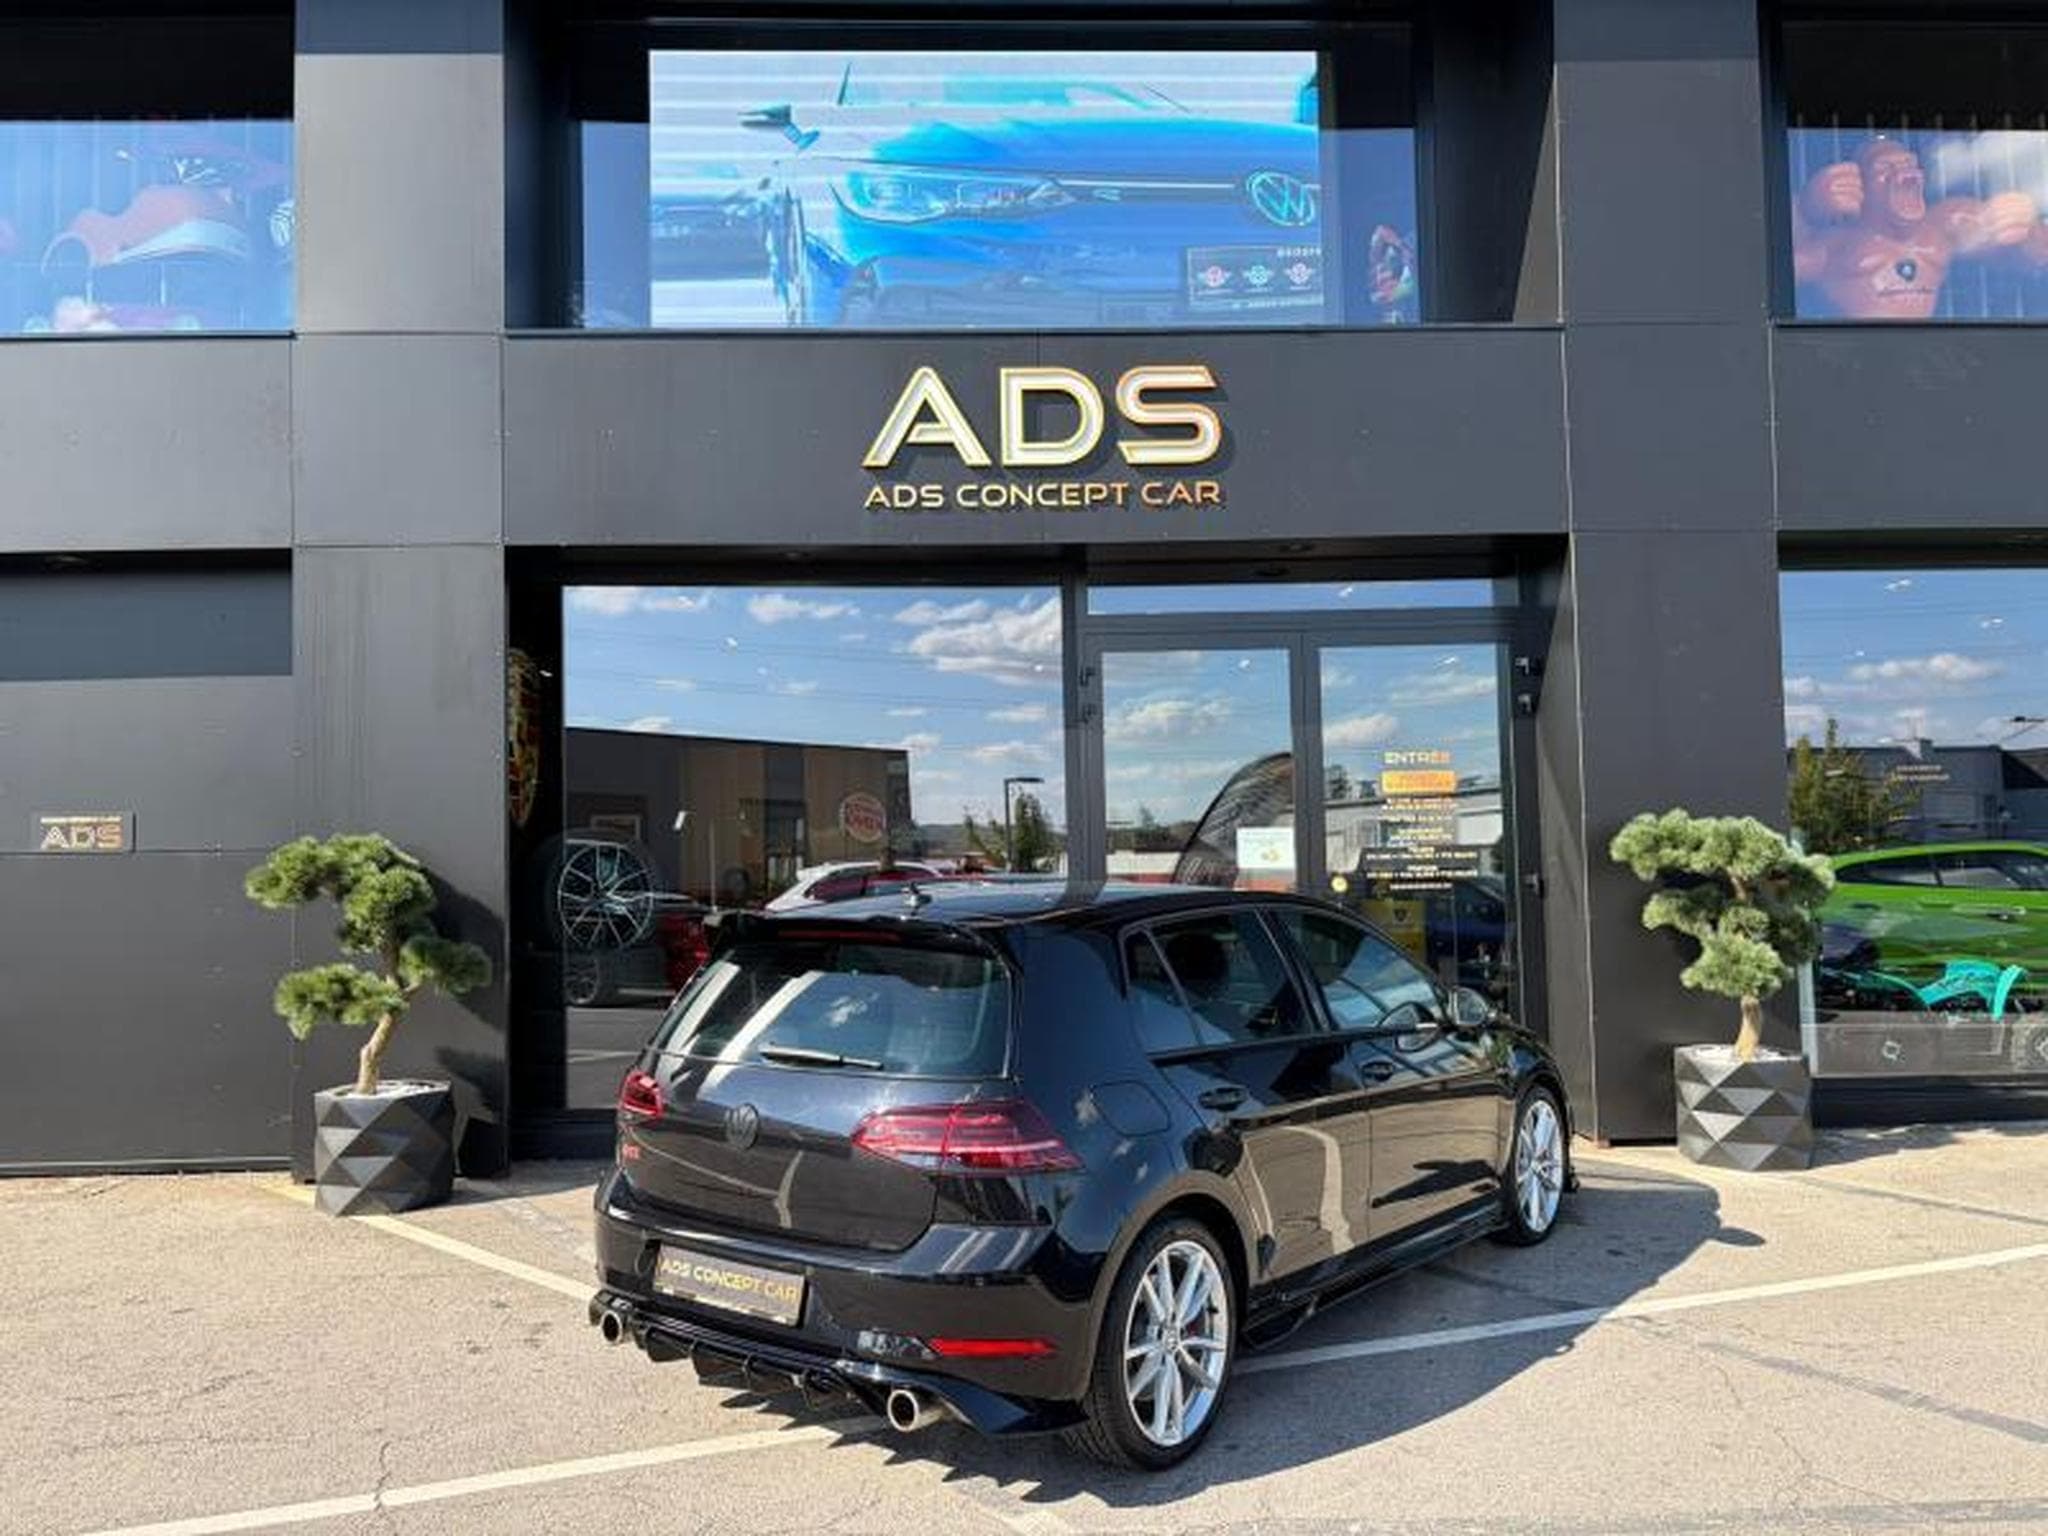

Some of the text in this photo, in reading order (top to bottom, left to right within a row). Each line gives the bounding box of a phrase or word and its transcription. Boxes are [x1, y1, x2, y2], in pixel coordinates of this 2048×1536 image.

[861, 365, 1223, 467] ADS
[864, 481, 1222, 508] ADS CONCEPT CAR
[40, 826, 122, 849] ADS
[660, 1258, 798, 1303] ADS CONCEPT CAR
